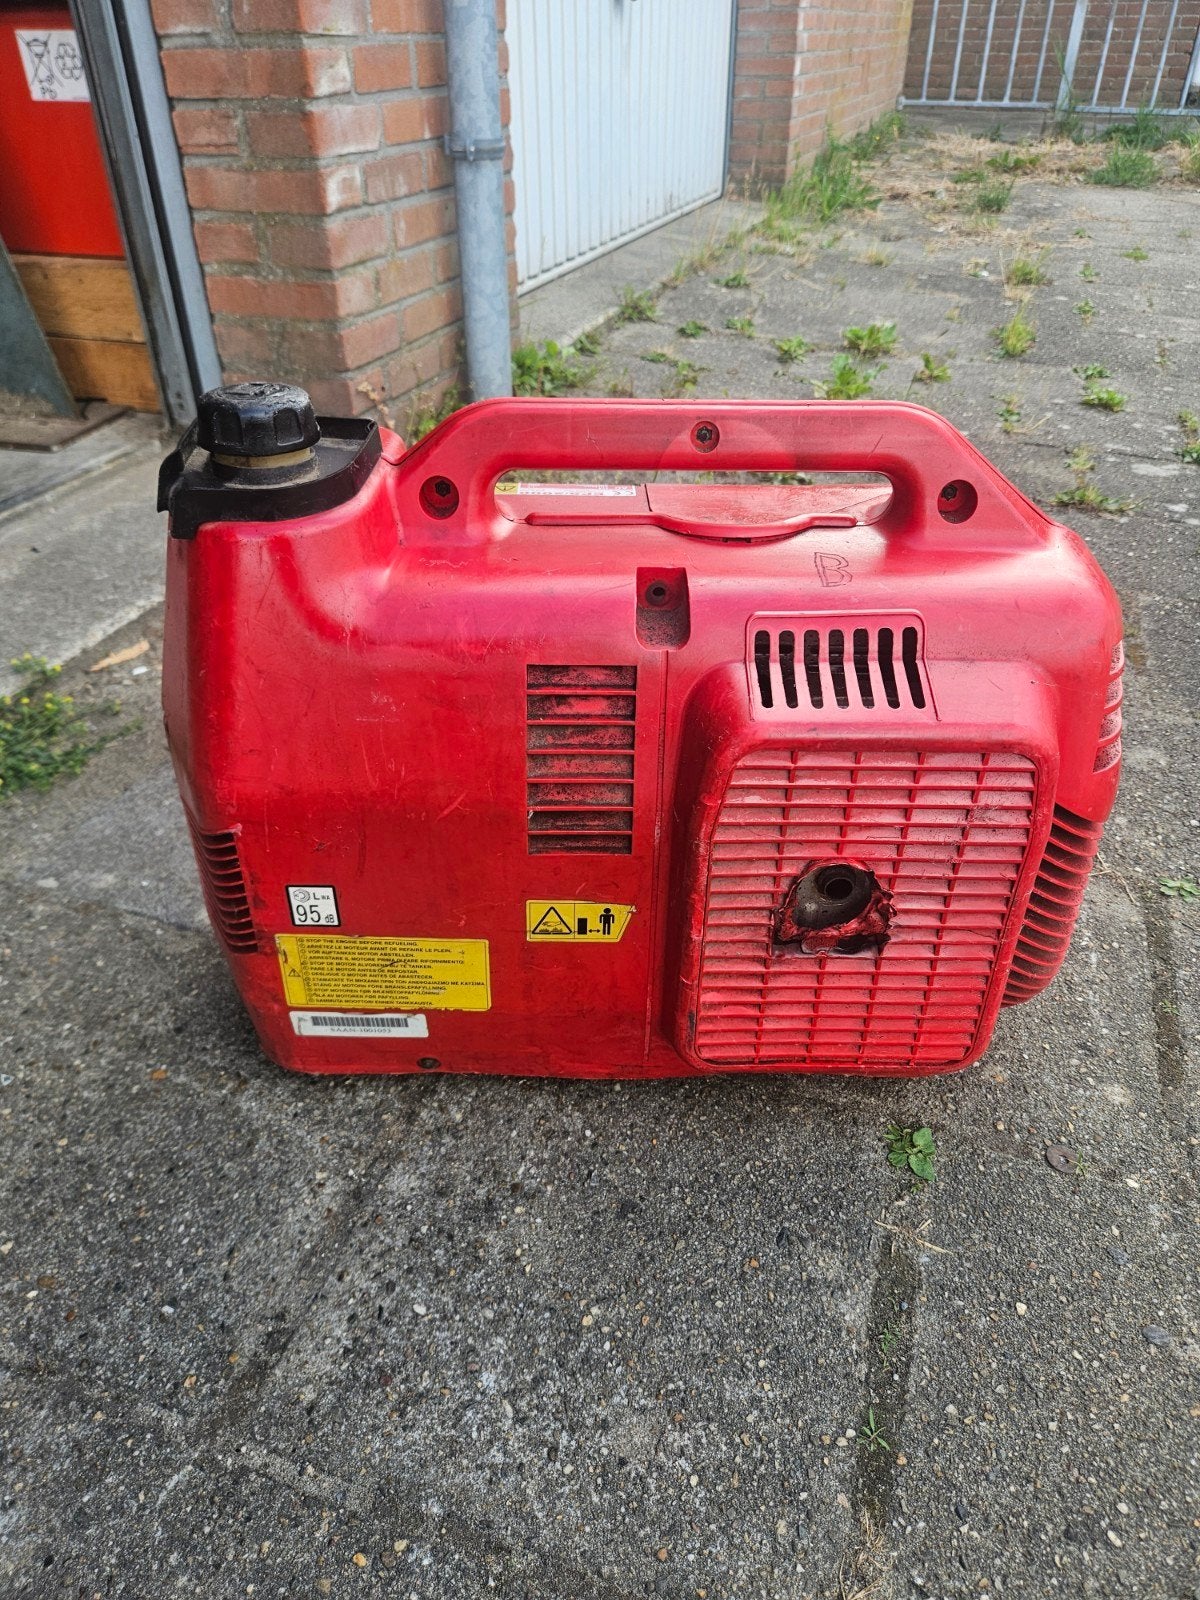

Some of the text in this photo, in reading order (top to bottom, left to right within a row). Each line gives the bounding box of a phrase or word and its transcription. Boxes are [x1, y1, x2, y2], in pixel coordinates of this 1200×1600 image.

[814, 552, 853, 587] B
[296, 904, 335, 923] 95 dB
